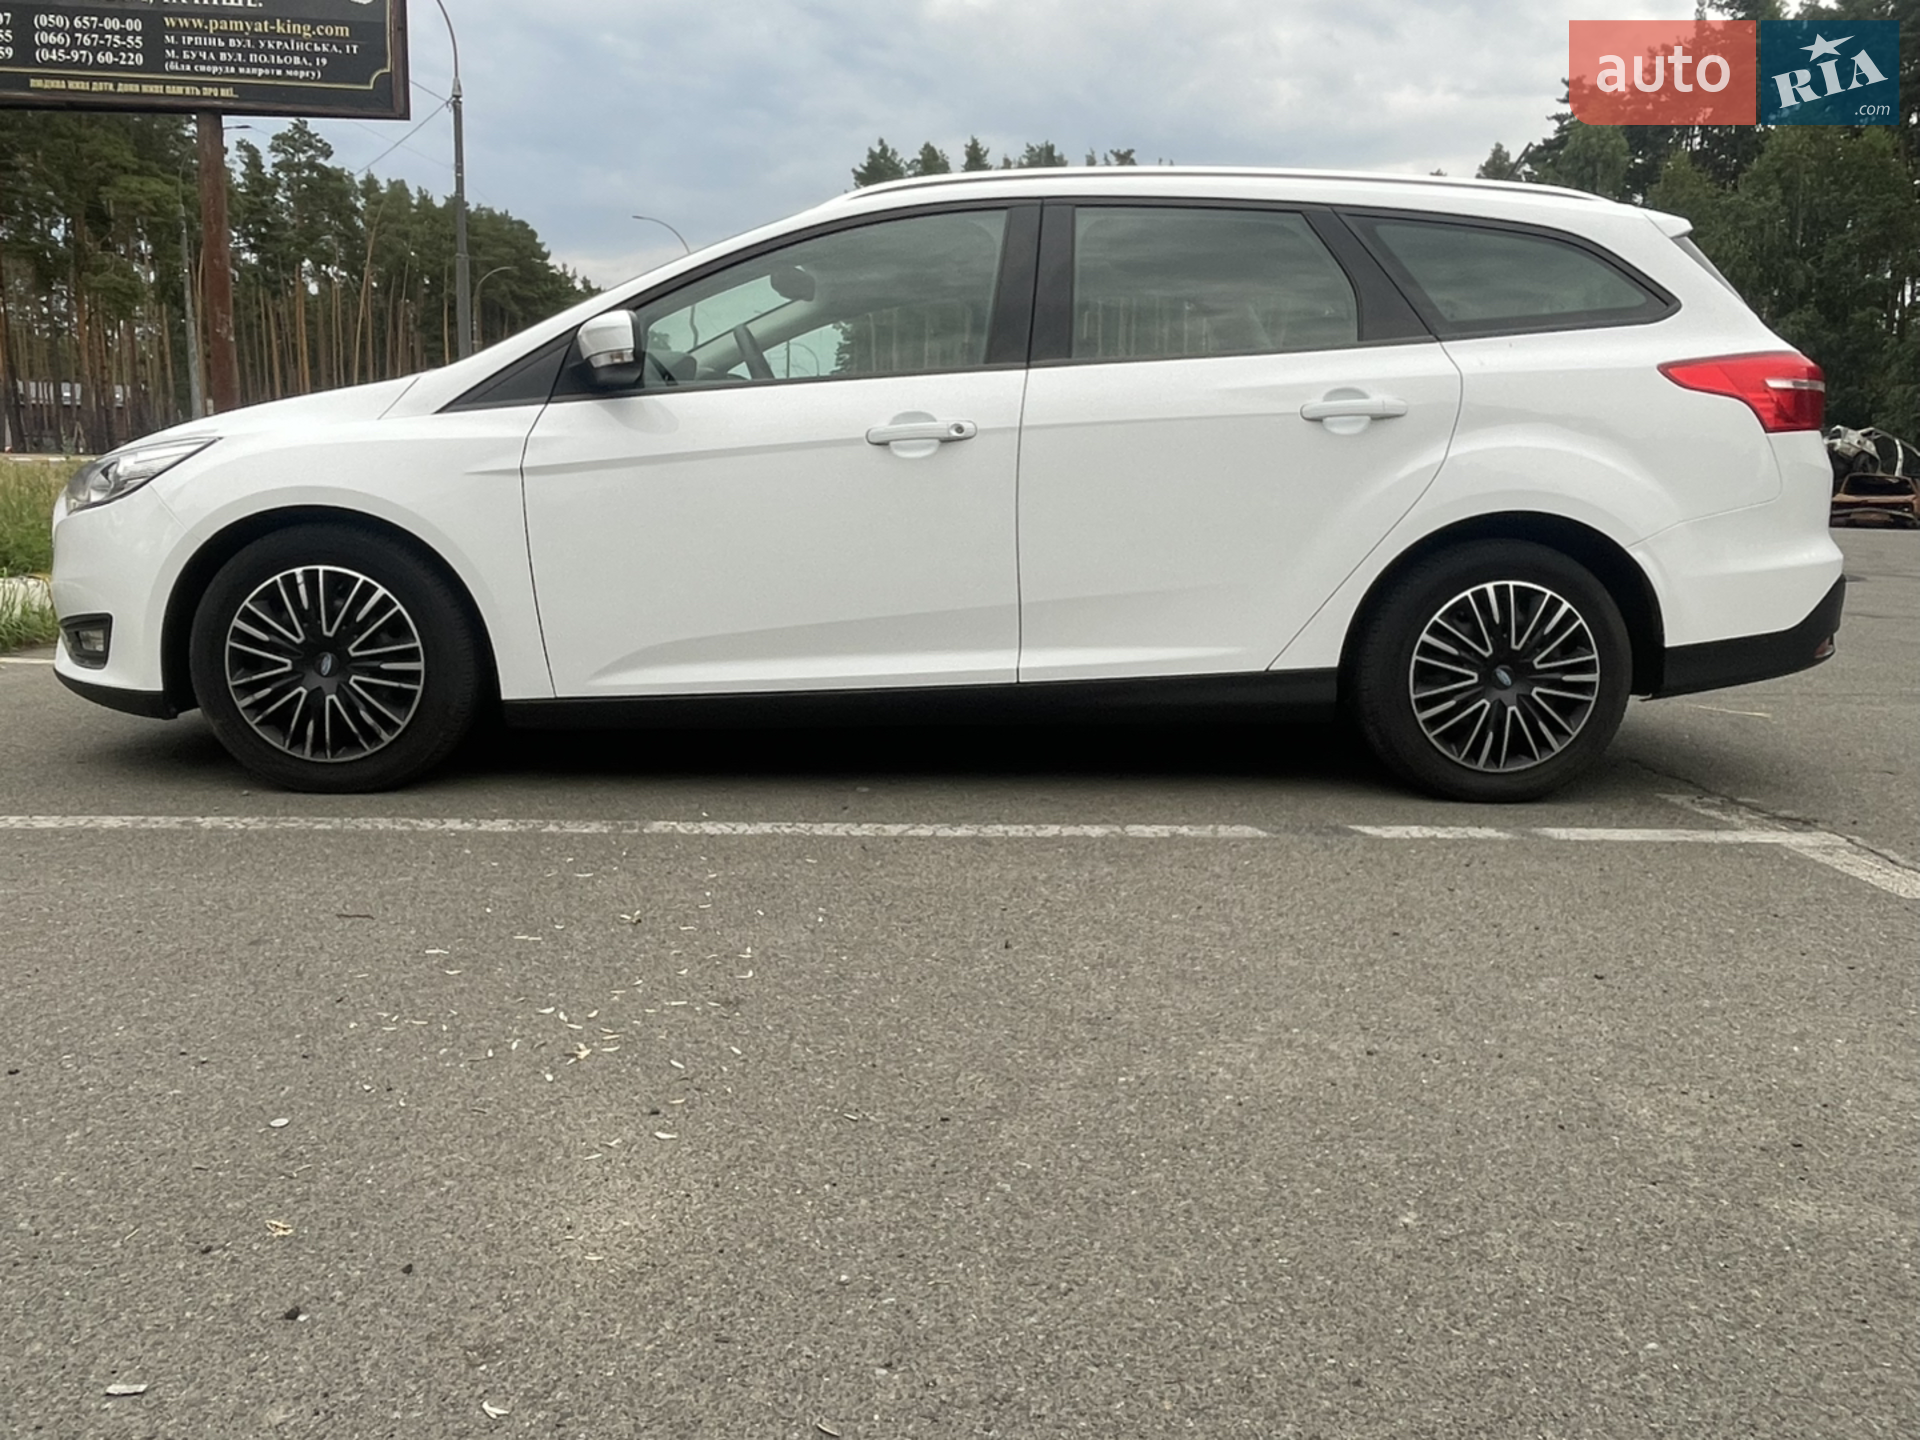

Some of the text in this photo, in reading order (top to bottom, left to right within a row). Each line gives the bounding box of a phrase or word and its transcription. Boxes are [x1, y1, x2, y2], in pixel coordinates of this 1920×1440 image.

[34, 14, 142, 32] (050) 657-00-00
[163, 16, 350, 38] www.pamyat-king.com
[34, 31, 143, 49] (066) 767-75-55
[35, 48, 143, 65] (045-97) 60-220
[182, 50, 216, 61] БУЧА
[220, 52, 246, 62] ВУЛ.
[316, 57, 327, 67] 19
